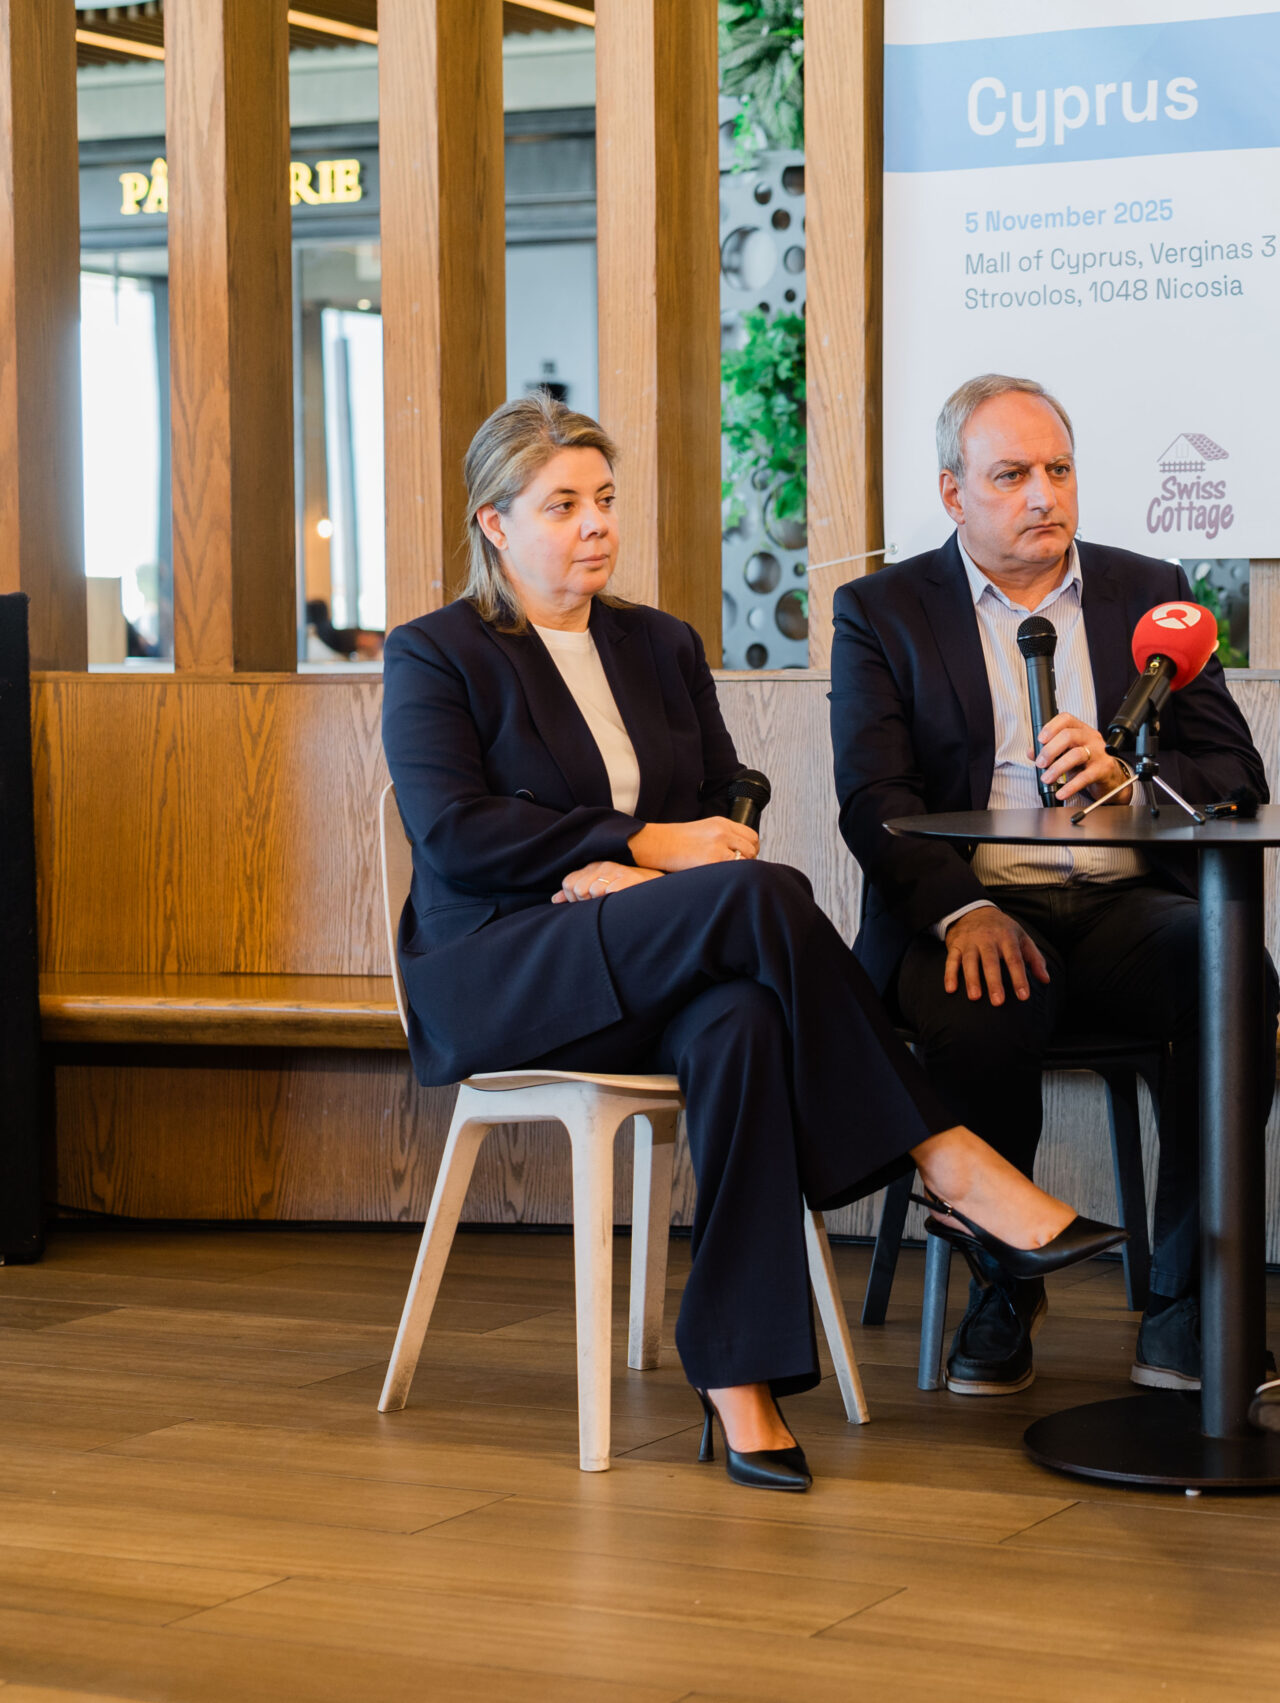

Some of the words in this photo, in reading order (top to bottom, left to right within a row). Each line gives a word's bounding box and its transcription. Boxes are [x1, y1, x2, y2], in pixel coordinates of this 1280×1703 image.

[967, 76, 1199, 148] Cyprus
[965, 211, 979, 233] 5
[985, 205, 1107, 232] November
[1113, 198, 1174, 224] 2025
[965, 251, 1011, 275] Mall
[1018, 249, 1043, 272] of
[1050, 247, 1143, 275] Cyprus,
[1150, 239, 1254, 268] Verginas
[1260, 234, 1277, 257] 3
[964, 284, 1082, 310] Strovolos,
[1088, 278, 1148, 303] 1048
[1156, 274, 1244, 300] Nicosia
[1160, 475, 1227, 502] Swiss
[1146, 496, 1235, 540] Cottage
